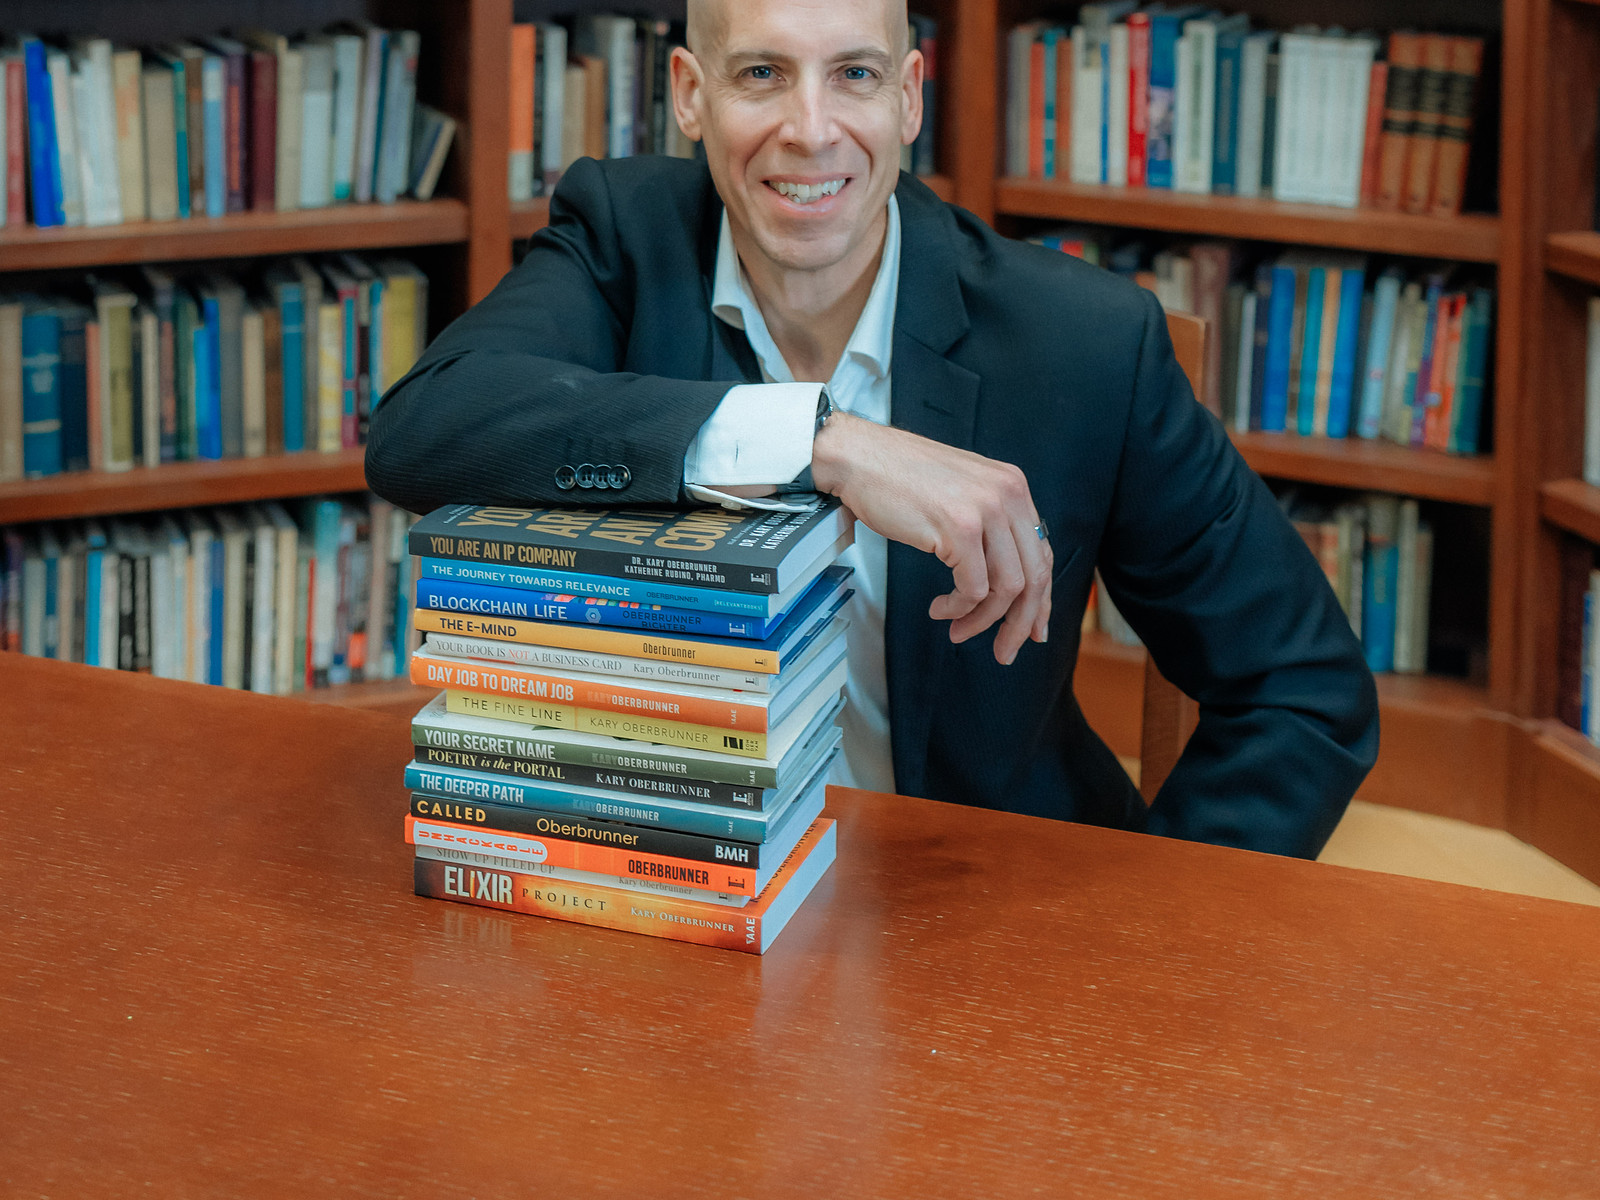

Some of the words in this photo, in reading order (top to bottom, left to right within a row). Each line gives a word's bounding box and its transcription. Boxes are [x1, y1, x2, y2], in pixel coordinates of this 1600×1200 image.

[589, 517, 664, 546] AN
[654, 509, 754, 551] COMP
[430, 536, 454, 555] YOU
[457, 538, 480, 558] ARE
[483, 541, 500, 560] AN
[503, 544, 515, 561] IP
[517, 545, 577, 567] COMPANY
[631, 556, 644, 566] DR.
[646, 558, 664, 568] KARY
[666, 559, 718, 573] OBERBRUNNER
[432, 565, 453, 576] THE
[456, 567, 505, 582] JOURNEY
[509, 574, 563, 589] TOWARDS
[565, 581, 630, 597] RELEVANCE
[624, 565, 663, 577] KATHERINE
[665, 568, 694, 581] RUBINO,
[429, 594, 527, 617] BLOCKCHAIN
[534, 604, 567, 620] LIFE
[646, 591, 699, 604] OBERBRUNNER
[440, 617, 463, 631] THE
[467, 620, 517, 637] E-MIND
[622, 610, 701, 625] OBERBRUNNER
[641, 620, 688, 632] RICHTER
[435, 640, 463, 654] YOUR
[466, 644, 494, 657] BOOK
[496, 647, 506, 658] IS
[508, 649, 530, 661] NOT
[532, 652, 540, 662] A
[542, 652, 590, 668] BUSINESS
[592, 659, 622, 672] CARD
[643, 642, 696, 659] Oberbrunner
[427, 665, 453, 683] DAY
[455, 669, 479, 687] JOB
[481, 673, 498, 690] TO
[501, 675, 548, 698] DREAM
[550, 683, 574, 701] JOB
[633, 663, 654, 675] Kary
[657, 666, 721, 682] Oberbrunner
[463, 697, 488, 711] THE
[494, 701, 525, 716] FINE
[531, 706, 562, 721] LINE
[590, 717, 617, 730] KARY
[623, 722, 709, 743] OBERBRUNNER
[424, 729, 461, 749] YOUR
[463, 734, 514, 754] SECRET
[516, 741, 556, 760] NAME
[427, 749, 478, 767] POETRY
[480, 757, 491, 768] is
[493, 757, 512, 771] the
[513, 762, 566, 780] PORTAL
[419, 773, 442, 791] THE
[444, 777, 490, 799] DEEPER
[492, 785, 524, 804] PATH
[596, 773, 626, 786] KARY
[628, 777, 711, 799] OBERBRUNNER
[416, 800, 487, 823] CALLED
[418, 830, 544, 856] UNHACKABLE
[536, 818, 639, 846] Oberbrunner
[436, 848, 468, 861] SHOW
[471, 853, 489, 864] UP
[493, 856, 536, 872] FILLED
[540, 863, 555, 875] UP
[715, 844, 749, 863] BMH
[628, 859, 709, 886] OBERBRUNNER
[444, 865, 513, 905] ELIXIR
[522, 887, 607, 911] PROJECT
[618, 877, 637, 888] Kary
[639, 879, 693, 896] Oberbrunner
[631, 907, 656, 919] KARY
[659, 911, 735, 933] OBERBRUNNER
